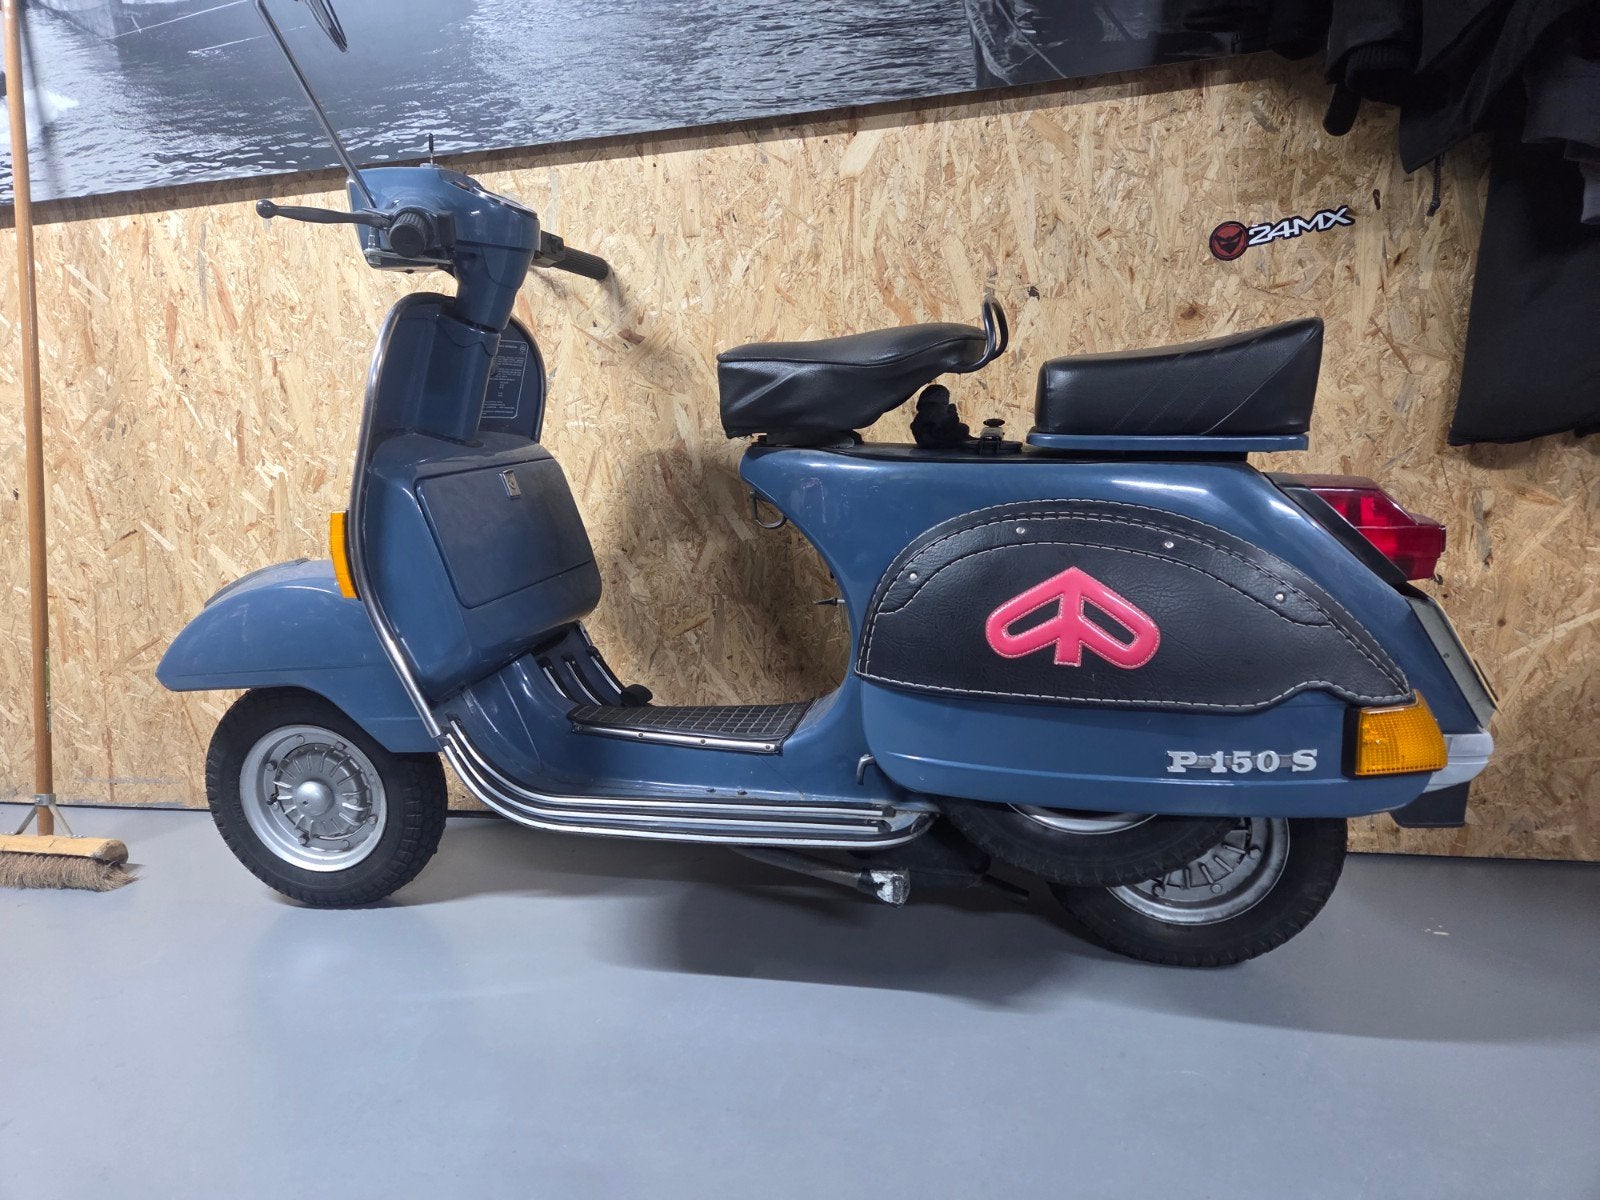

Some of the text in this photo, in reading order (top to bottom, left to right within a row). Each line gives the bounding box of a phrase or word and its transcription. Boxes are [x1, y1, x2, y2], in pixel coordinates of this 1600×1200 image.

[1248, 207, 1353, 246] 24MX
[1167, 749, 1318, 774] P 150 S
